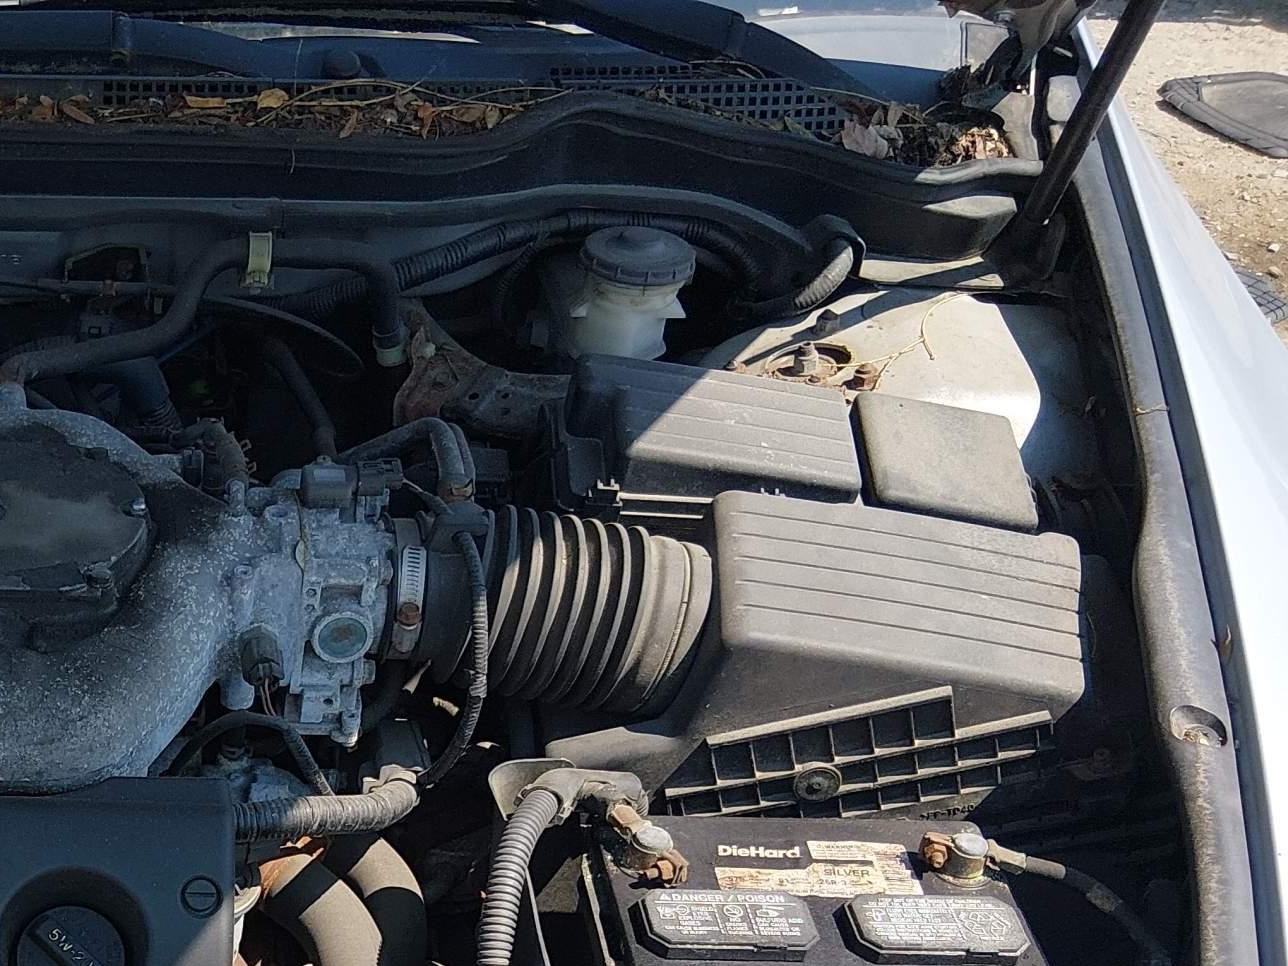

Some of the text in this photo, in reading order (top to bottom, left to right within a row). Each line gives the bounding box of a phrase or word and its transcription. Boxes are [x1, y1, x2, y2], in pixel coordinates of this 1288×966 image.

[716, 844, 801, 859] DieHard
[823, 868, 870, 878] SILVER
[671, 893, 724, 902] DANGER
[737, 894, 785, 903] POISON
